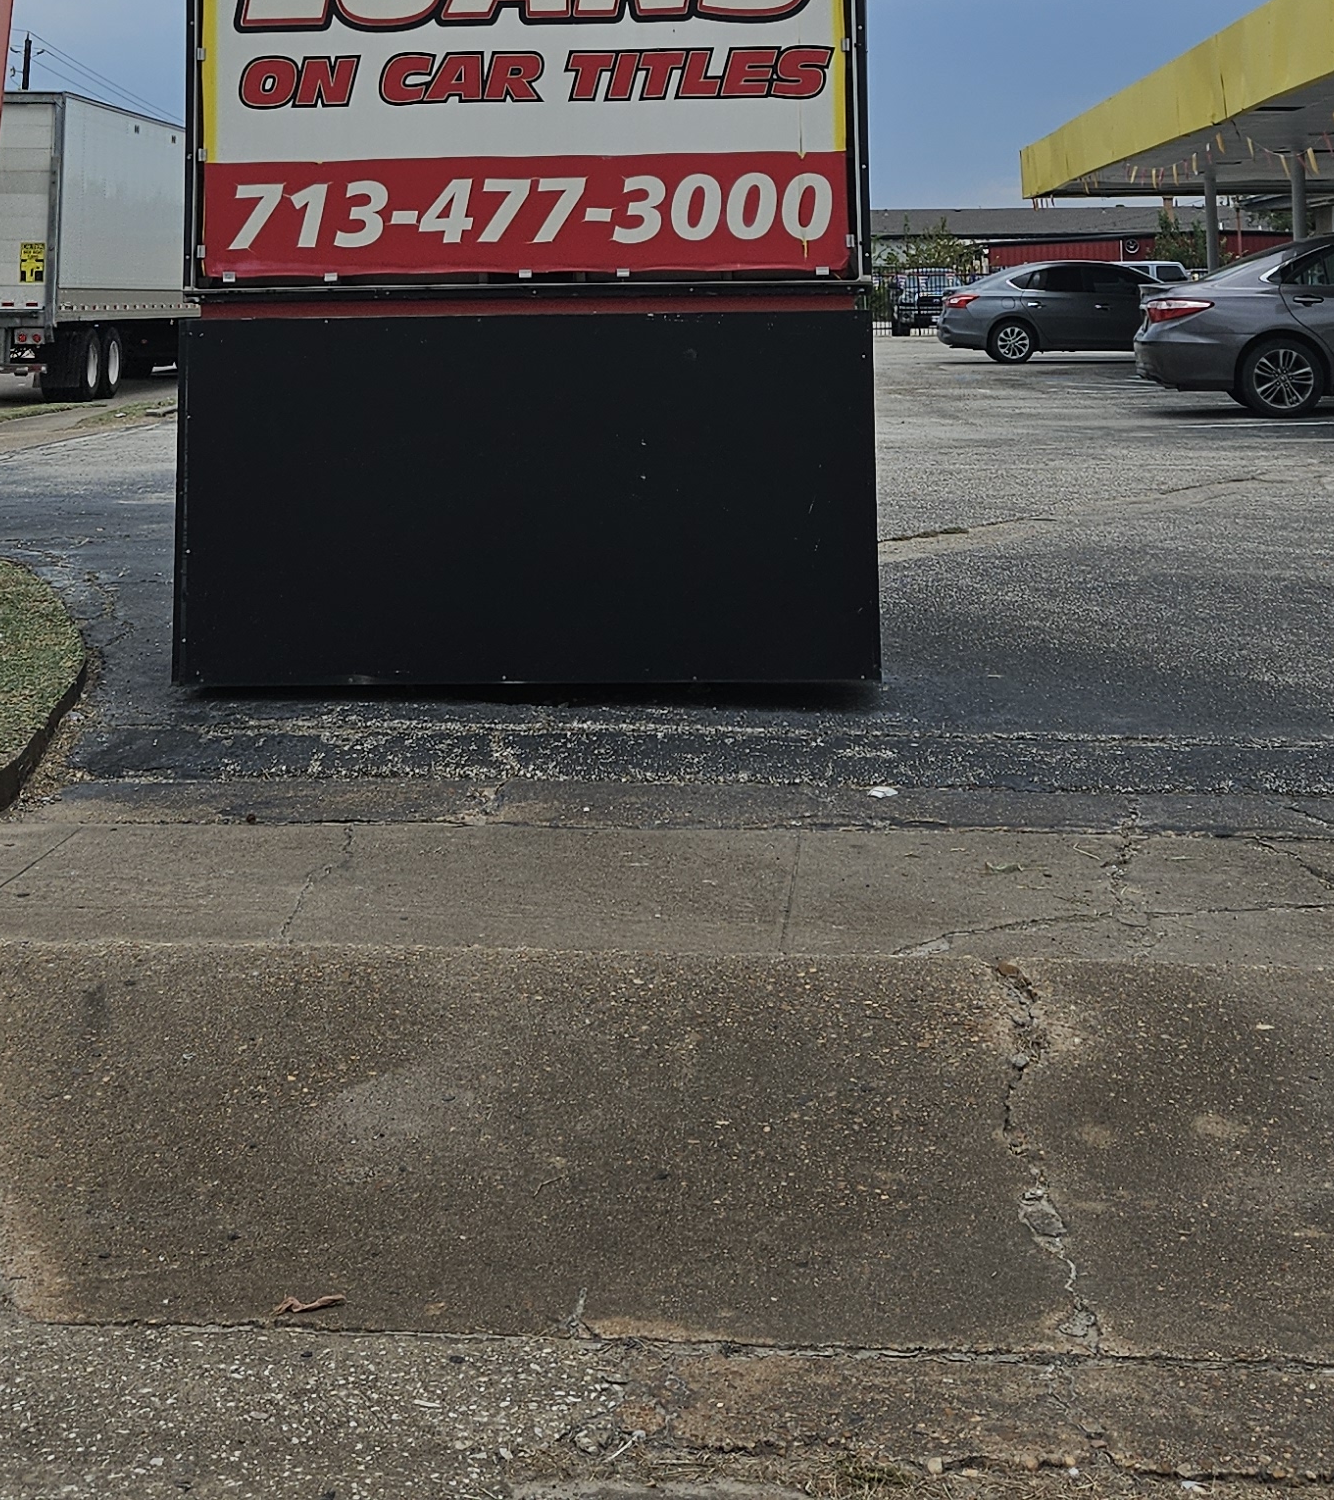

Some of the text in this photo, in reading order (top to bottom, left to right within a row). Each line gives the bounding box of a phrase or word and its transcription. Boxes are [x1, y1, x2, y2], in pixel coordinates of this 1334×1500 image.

[240, 46, 834, 108] ON CAR TITLES
[228, 171, 833, 250] 713-477-3000
